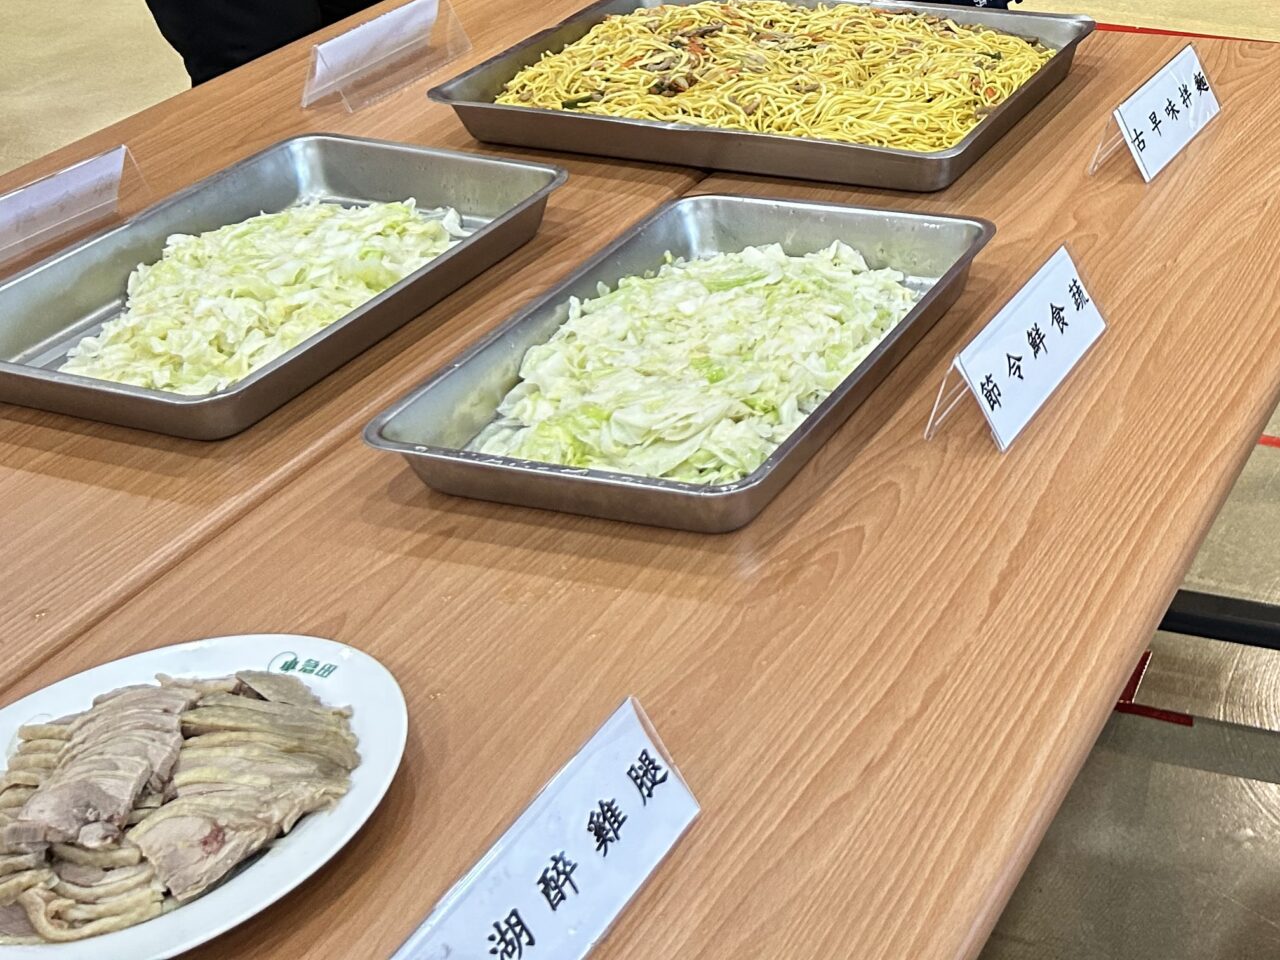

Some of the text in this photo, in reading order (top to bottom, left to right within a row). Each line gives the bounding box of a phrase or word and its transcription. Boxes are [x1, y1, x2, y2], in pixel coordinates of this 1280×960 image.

[980, 278, 1090, 412] 節令鮮食蔬
